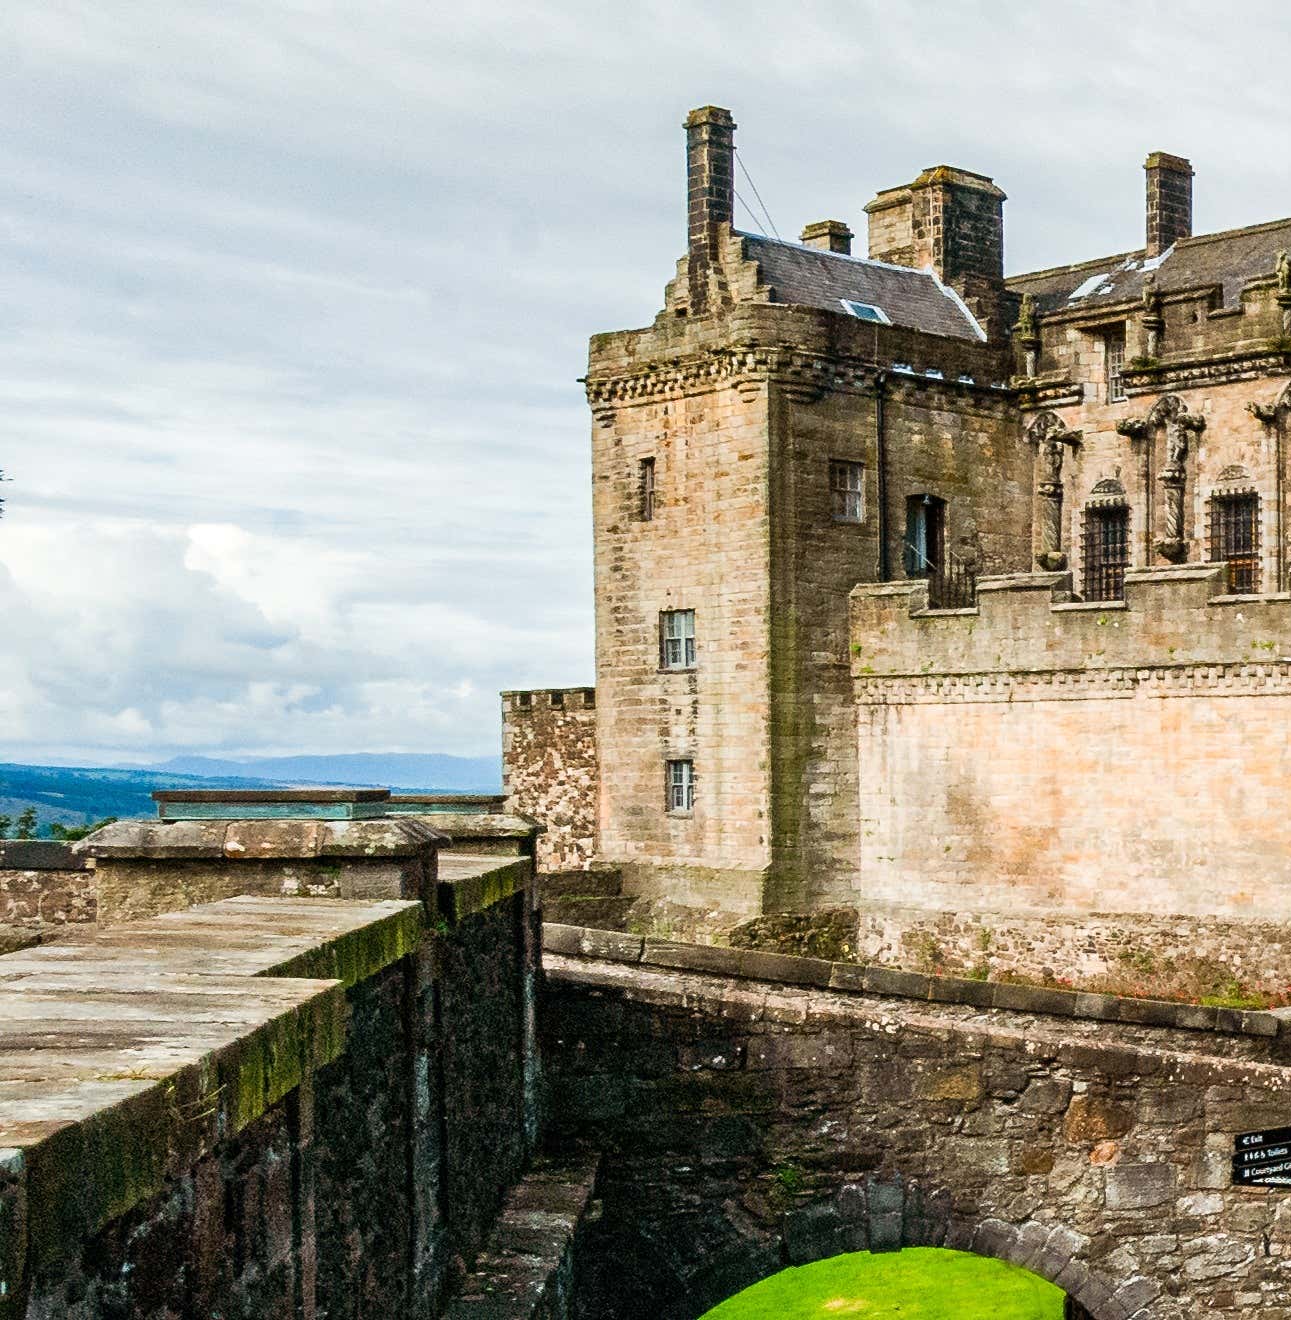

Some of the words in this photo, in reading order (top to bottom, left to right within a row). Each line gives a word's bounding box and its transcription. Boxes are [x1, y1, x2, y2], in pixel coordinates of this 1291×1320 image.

[1250, 1134, 1263, 1143] Exit
[1267, 1147, 1288, 1156] Toilets
[1251, 1162, 1284, 1176] Courtyard
